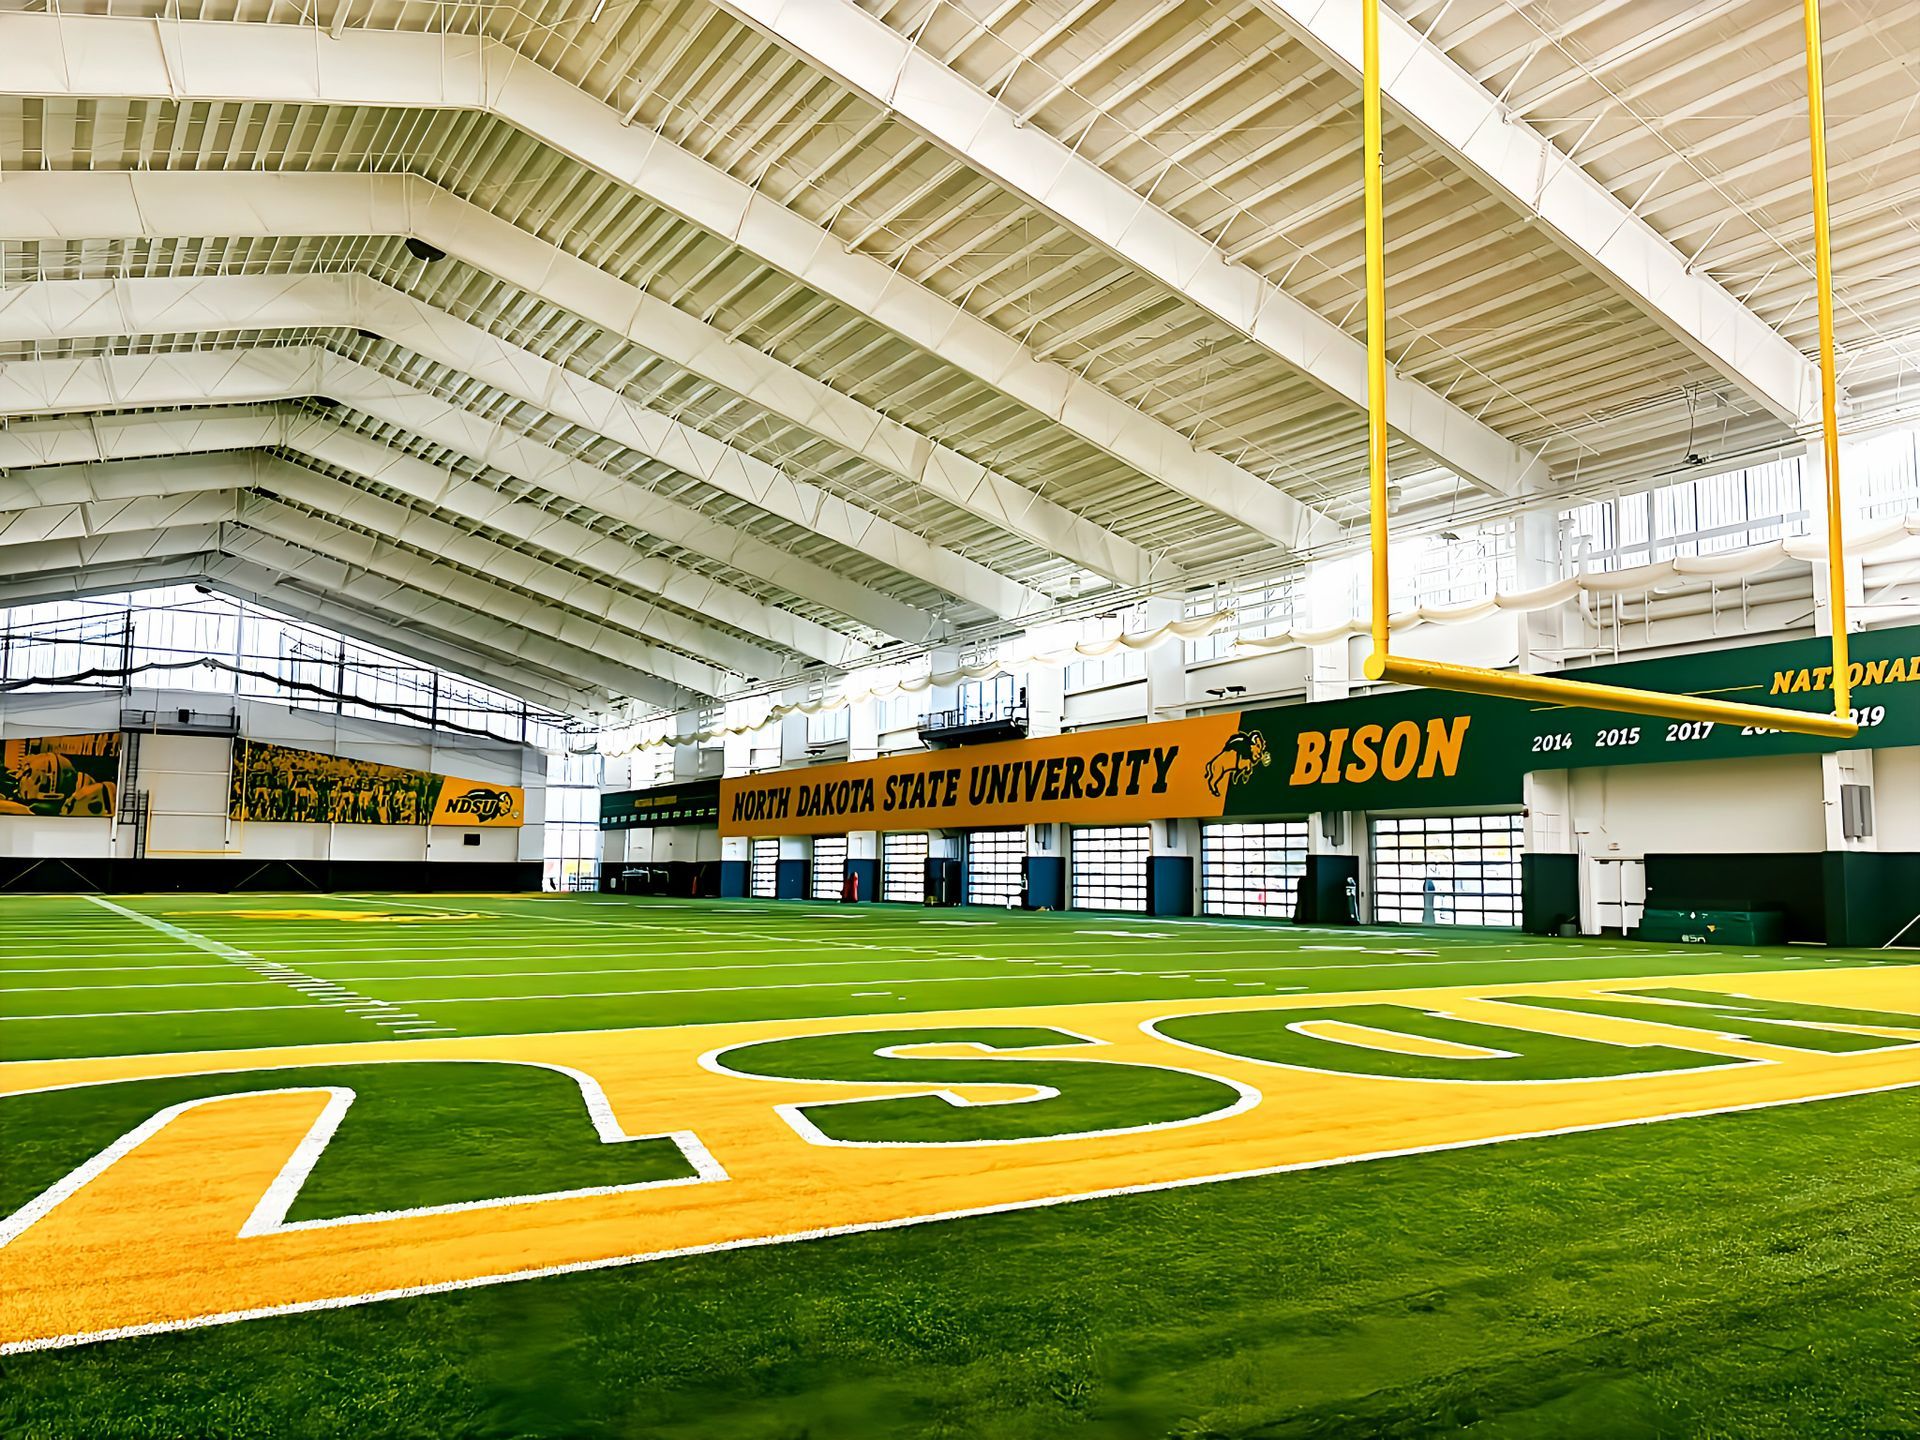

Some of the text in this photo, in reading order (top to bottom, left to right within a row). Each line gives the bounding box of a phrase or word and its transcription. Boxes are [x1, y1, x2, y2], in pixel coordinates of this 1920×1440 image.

[1769, 655, 1920, 695] NATONAL
[1289, 715, 1471, 786] BISON
[1531, 705, 1886, 752] 2014 2015 2017 19
[445, 798, 497, 814] NDSU
[732, 786, 791, 822] NORTH
[795, 778, 875, 817] DAKOTA
[883, 768, 961, 812] STATE
[968, 745, 1179, 806] UNIVERSITY
